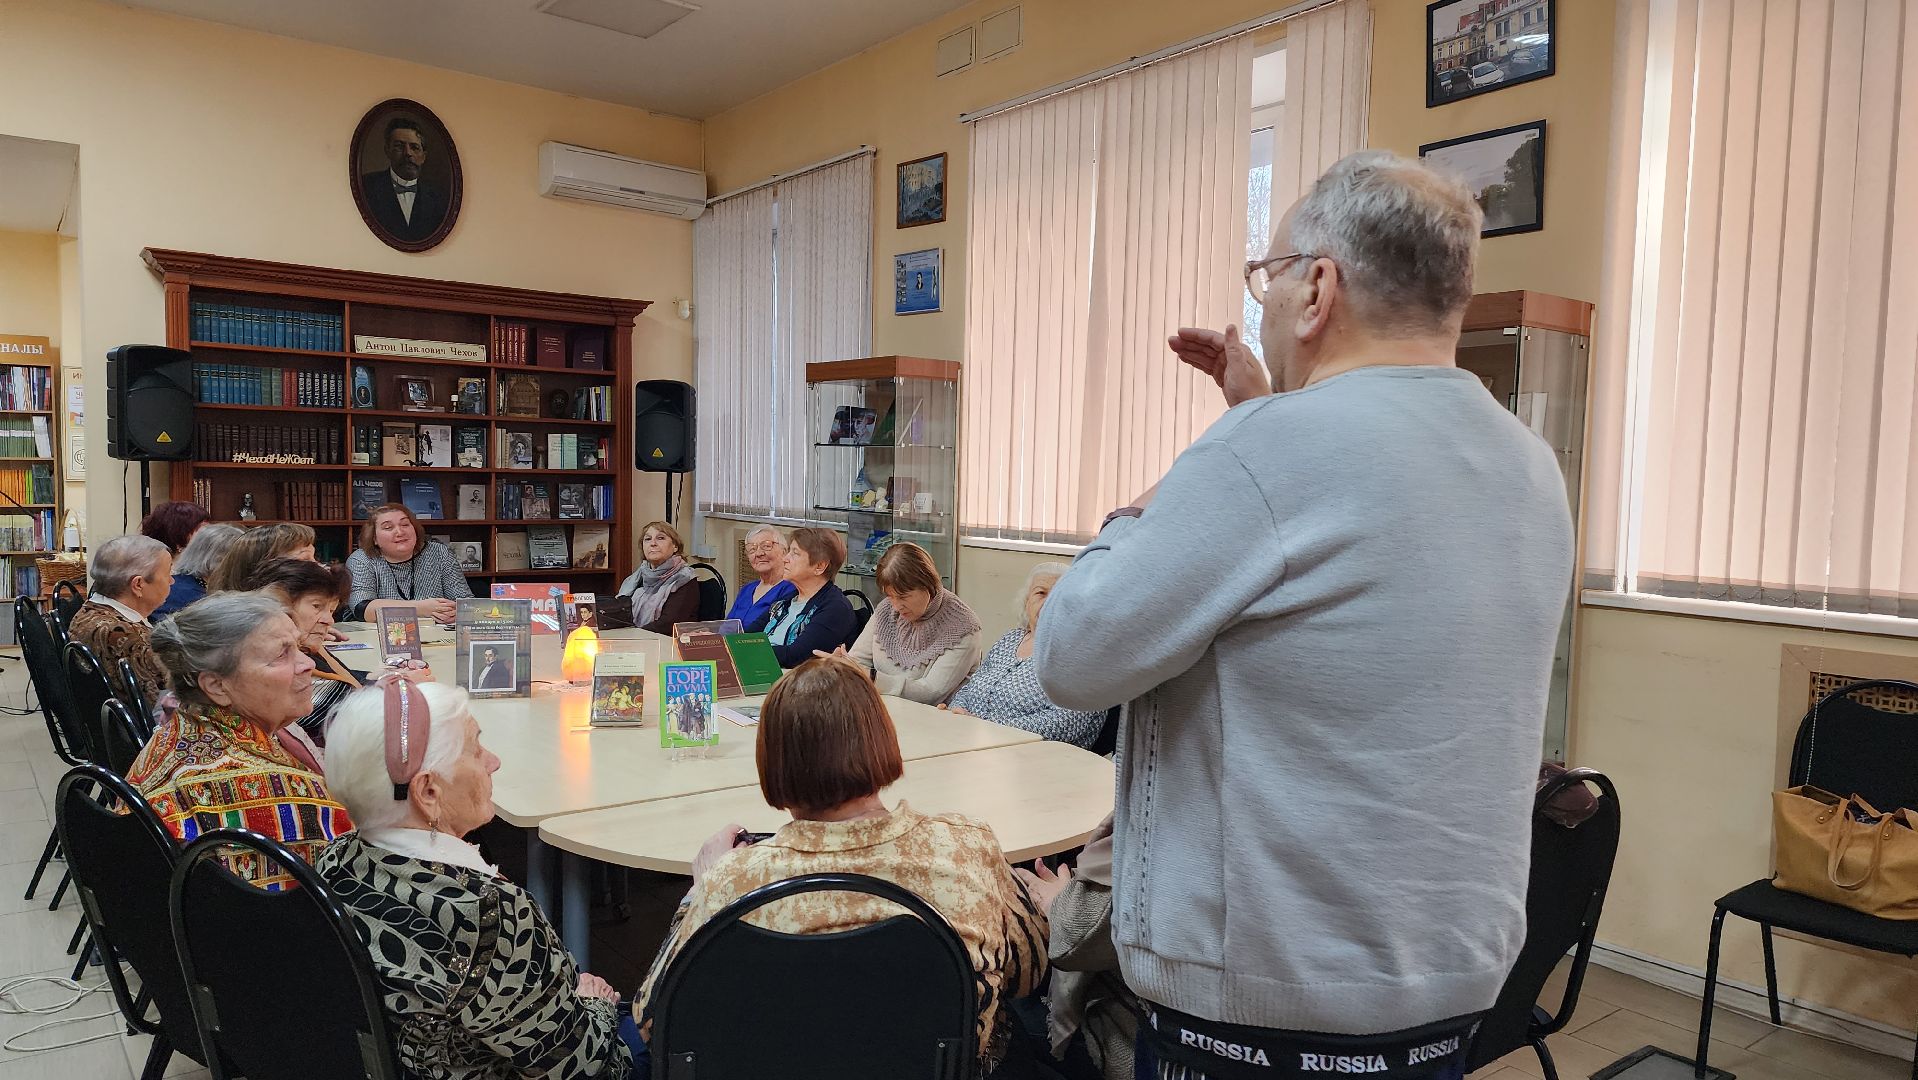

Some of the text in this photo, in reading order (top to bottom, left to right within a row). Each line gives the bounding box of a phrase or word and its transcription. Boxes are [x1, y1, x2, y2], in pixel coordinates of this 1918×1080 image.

[365, 340, 479, 357] Антон Павлович Чехов
[667, 670, 710, 685] ГОРЕ
[667, 684, 708, 693] ОТ УМА
[1180, 1028, 1271, 1067] RUSSIA
[1407, 1037, 1460, 1066] RUSSIA
[1300, 1053, 1388, 1074] RUSSIA
